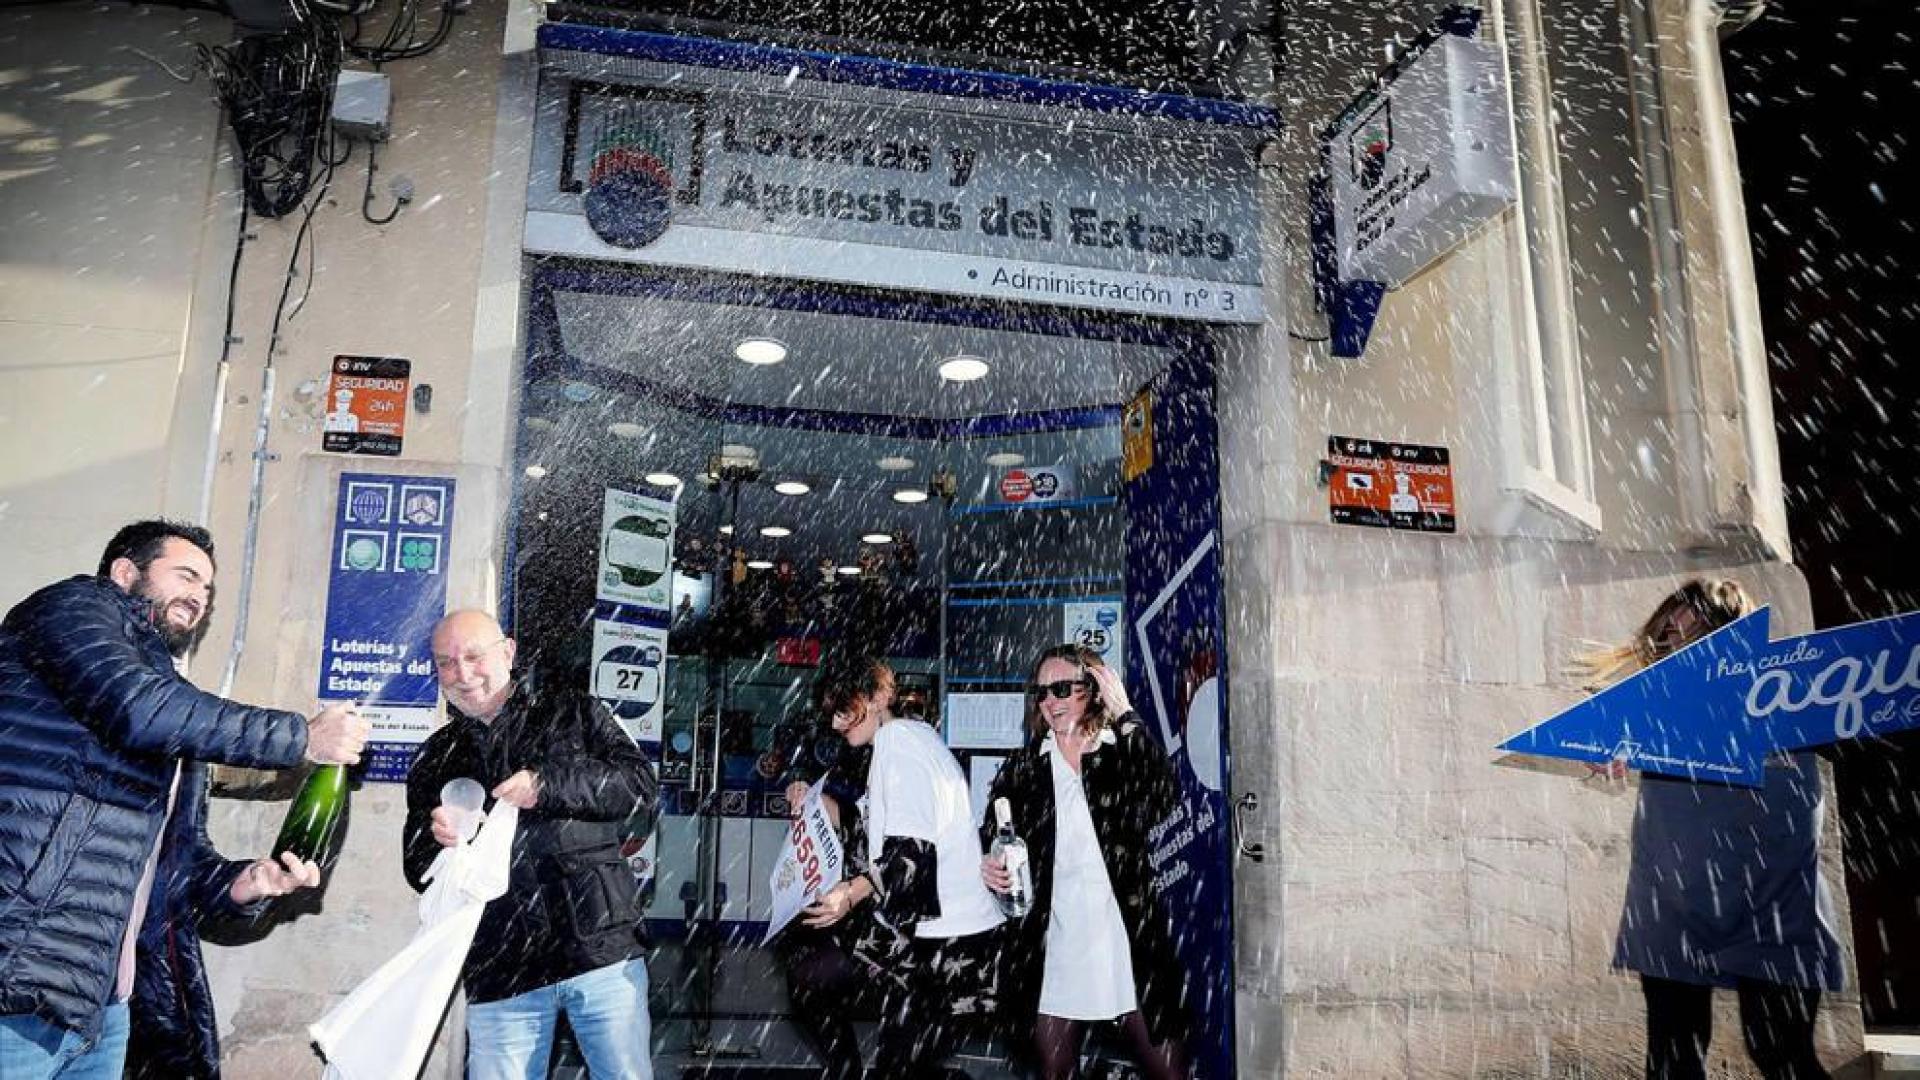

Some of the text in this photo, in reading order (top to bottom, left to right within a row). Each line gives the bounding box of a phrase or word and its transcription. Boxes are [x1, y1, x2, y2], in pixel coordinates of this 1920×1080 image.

[723, 115, 977, 187] Loterías y
[721, 168, 1235, 262] Apuestas del Estado
[991, 266, 1172, 306] Administración
[1222, 290, 1235, 313] 3
[335, 376, 404, 392] SEGURIDAD
[1392, 461, 1447, 475] SEGURIDAD
[331, 637, 408, 659] Loterías y
[1081, 629, 1105, 647] 25
[330, 657, 432, 675] Apuestas del
[327, 676, 381, 691] Estado
[616, 668, 644, 690] 27
[811, 808, 838, 870] PREMIO
